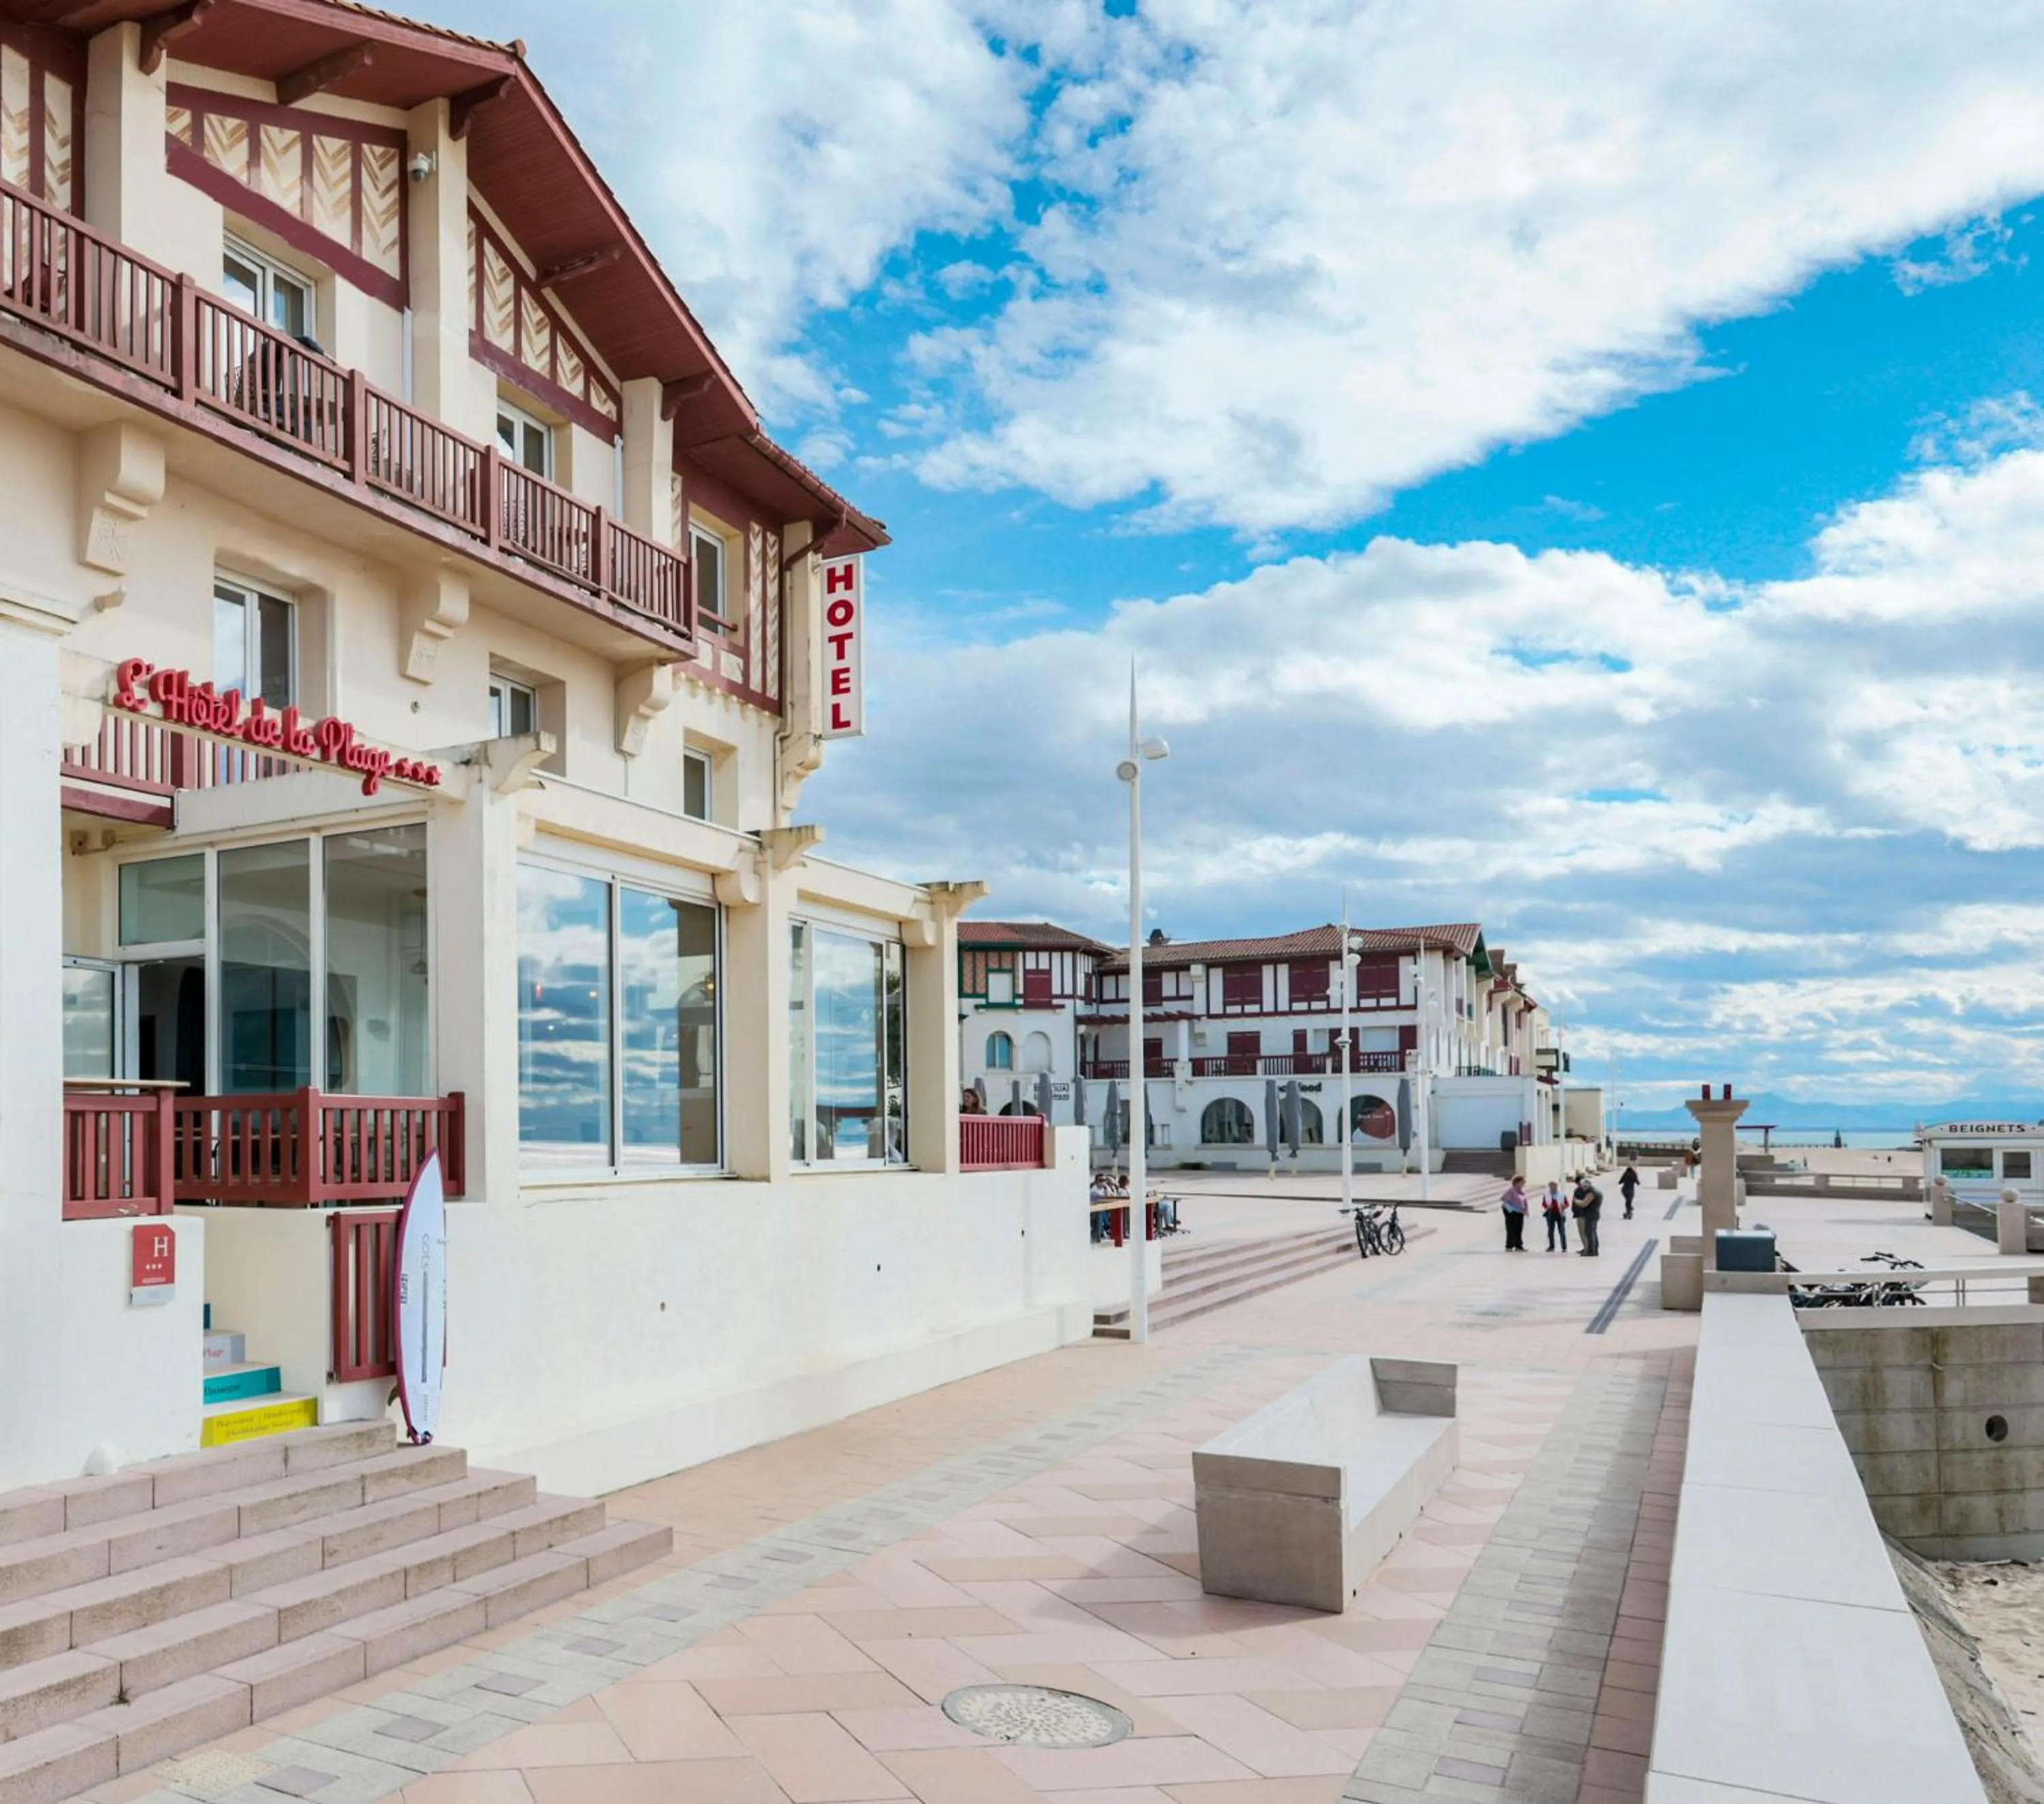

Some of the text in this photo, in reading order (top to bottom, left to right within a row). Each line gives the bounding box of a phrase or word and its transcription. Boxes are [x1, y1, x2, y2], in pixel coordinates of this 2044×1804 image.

[826, 563, 854, 730] HOTEL
[243, 698, 284, 747] de
[281, 706, 315, 756] la
[314, 717, 395, 796] Plage
[1949, 1125, 2026, 1133] BEIGNETS
[153, 1236, 169, 1258] H
